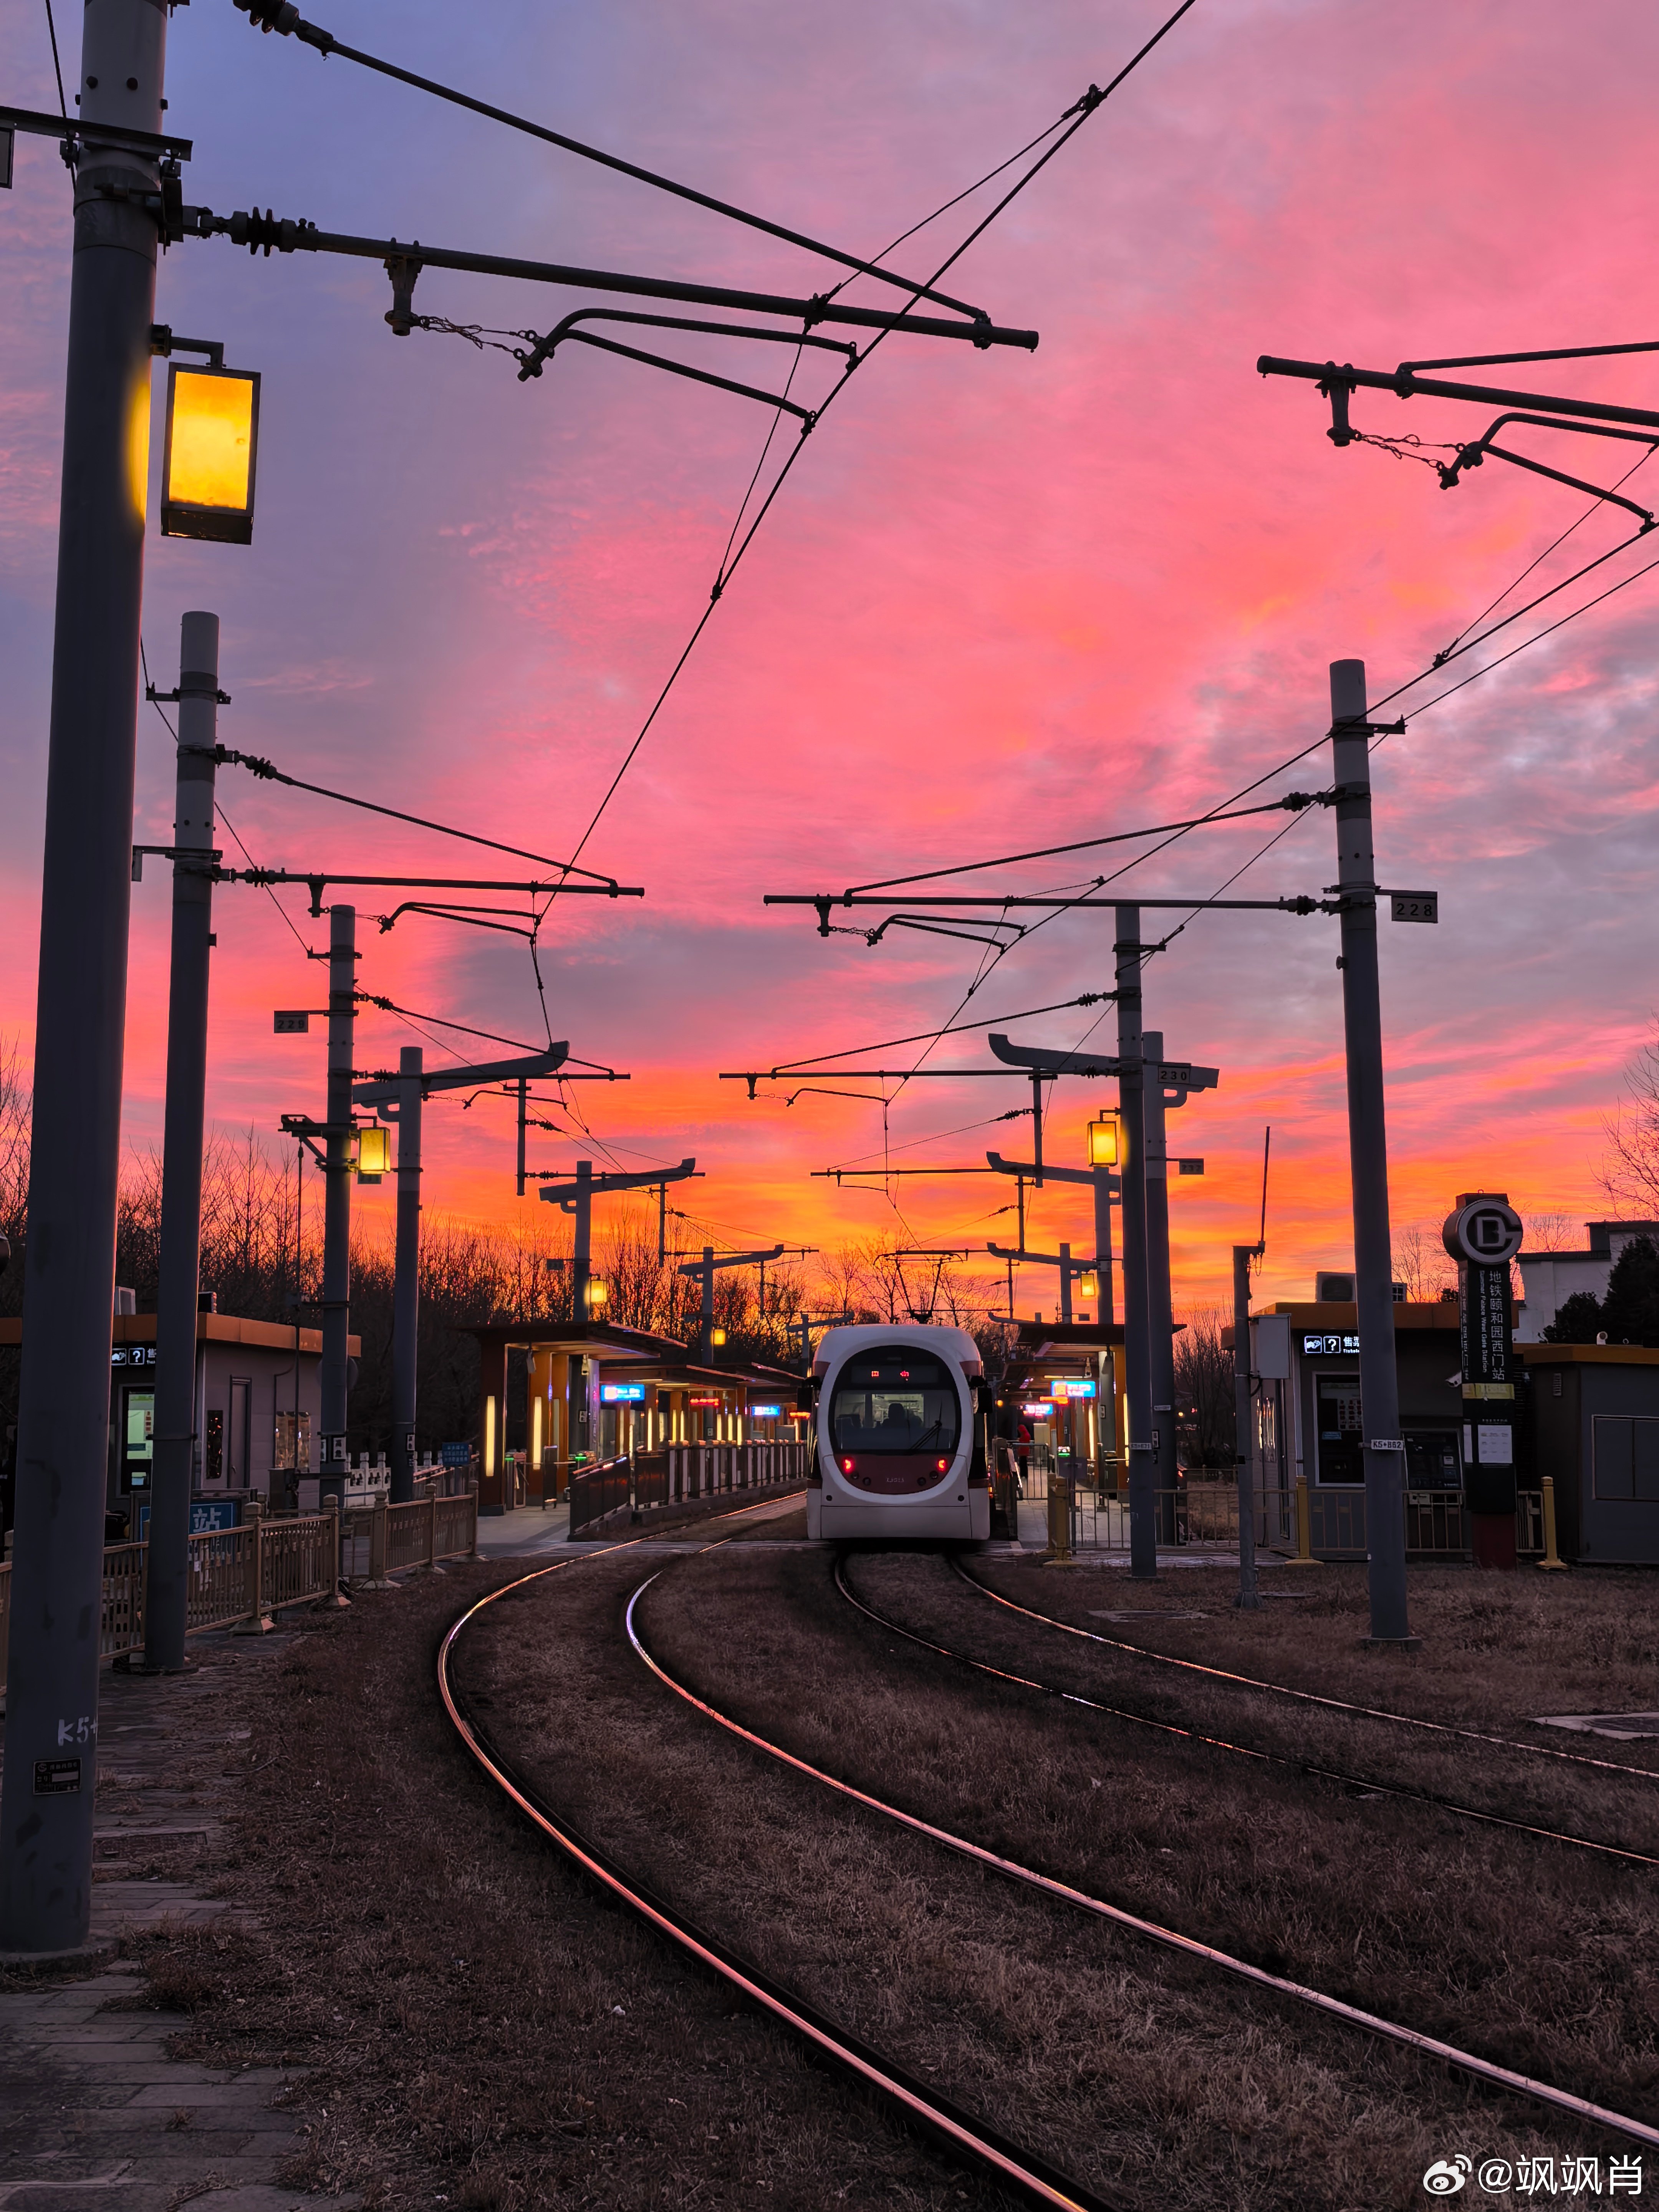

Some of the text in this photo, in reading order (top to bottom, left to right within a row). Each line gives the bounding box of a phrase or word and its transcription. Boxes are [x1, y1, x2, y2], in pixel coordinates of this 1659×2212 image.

[1396, 903, 1433, 917] 228
[1161, 1070, 1187, 1081] 230
[1489, 1270, 1506, 1381] 地铁颐和园西门站
